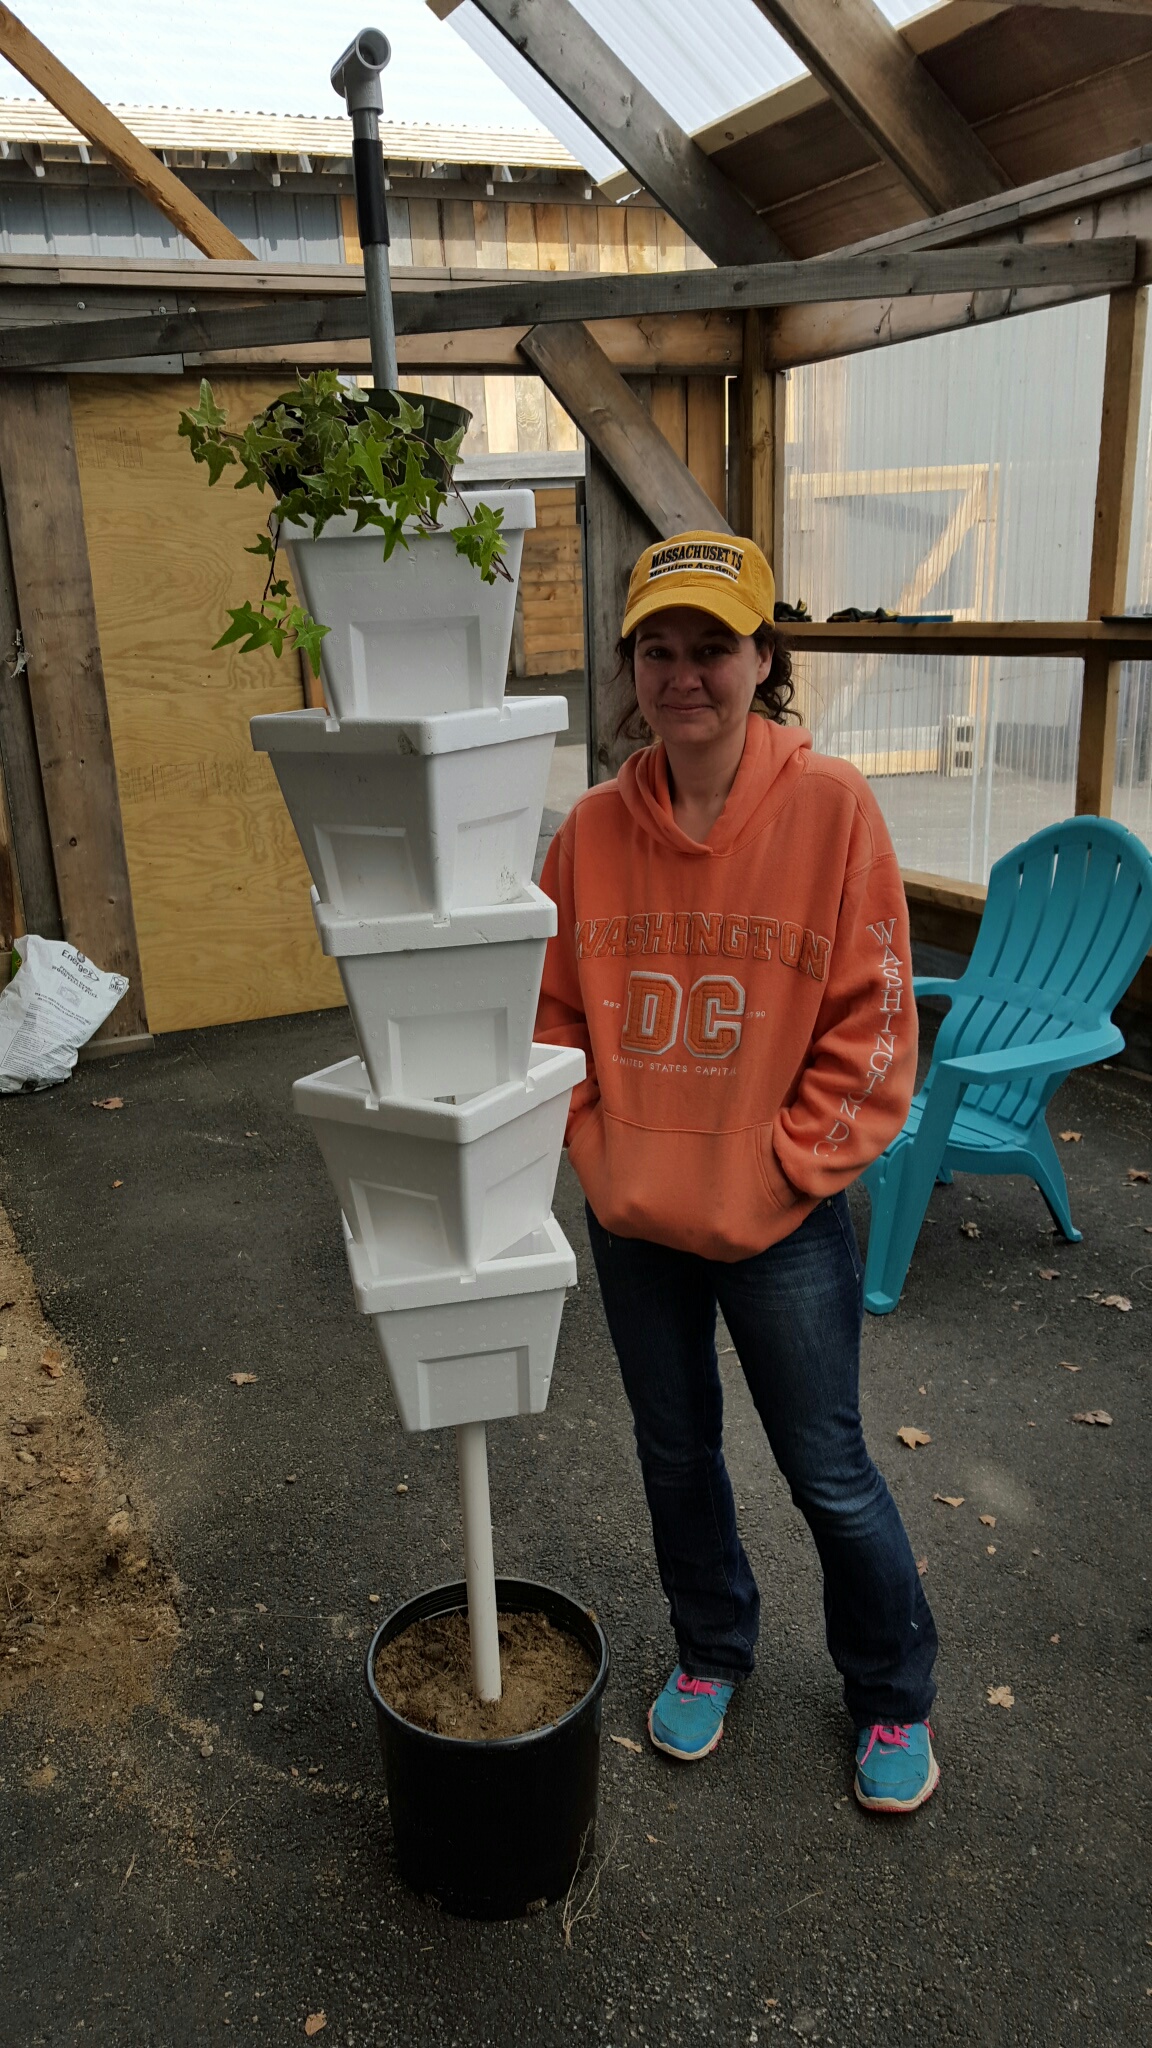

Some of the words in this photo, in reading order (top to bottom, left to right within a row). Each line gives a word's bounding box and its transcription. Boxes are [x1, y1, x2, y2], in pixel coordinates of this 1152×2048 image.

[650, 563, 693, 578] Maritime
[696, 562, 737, 580] Academy
[651, 544, 743, 571] MASSACHUSETTS
[574, 912, 831, 981] WASHINGTON
[61, 949, 93, 977] Energex
[621, 971, 746, 1059] DC
[840, 918, 903, 1120] WASHINGTON
[612, 1054, 644, 1068] UNITED
[649, 1062, 688, 1073] STATES
